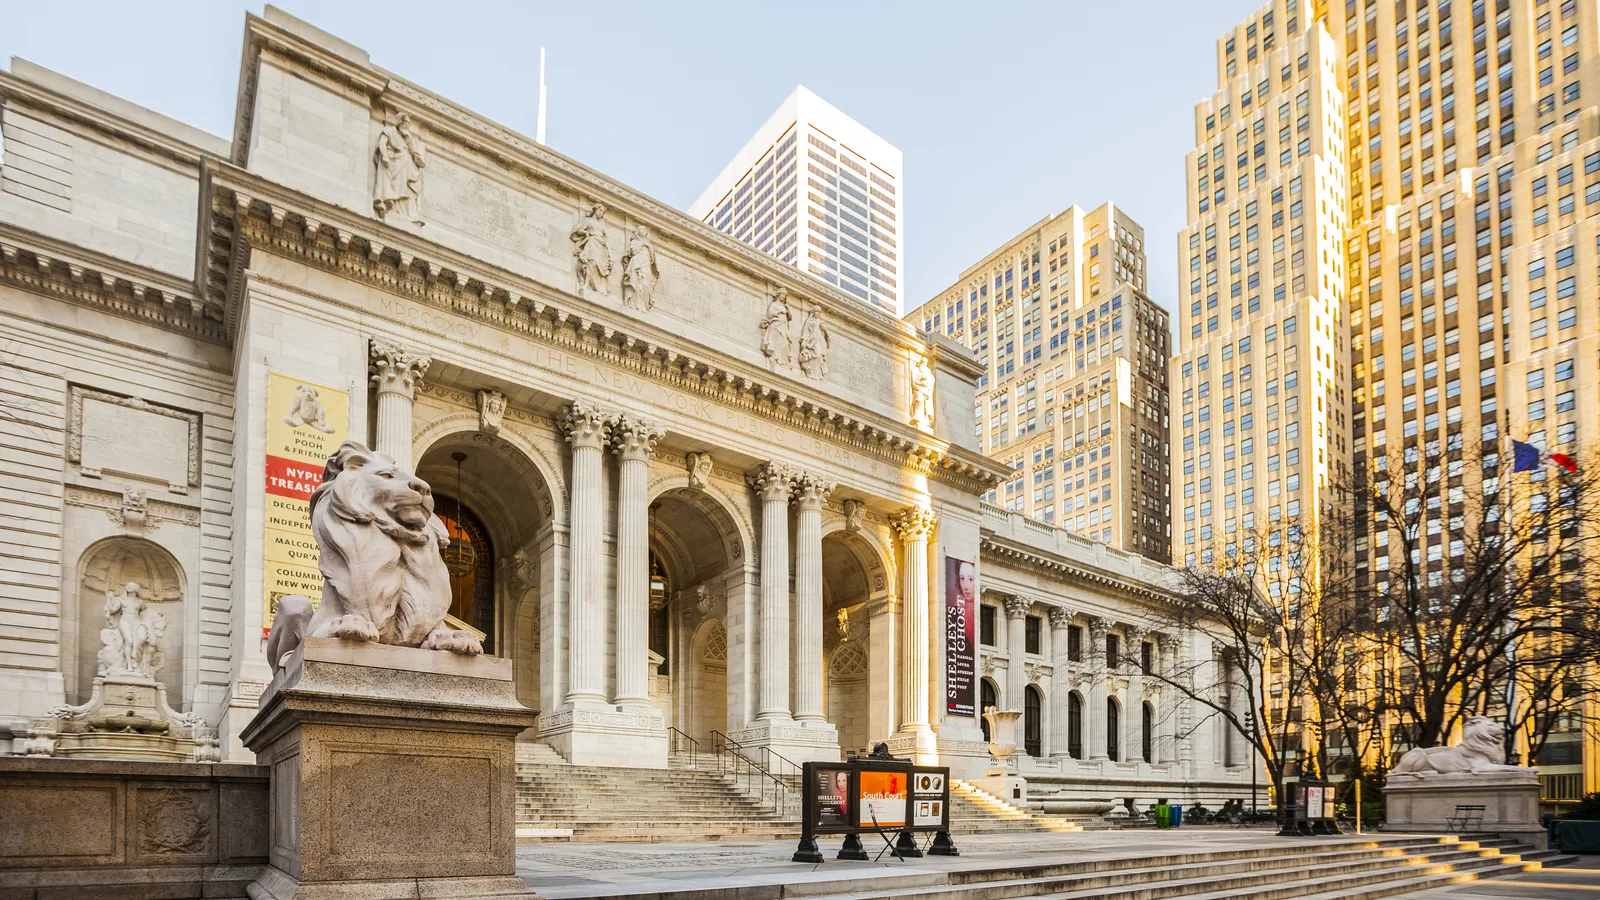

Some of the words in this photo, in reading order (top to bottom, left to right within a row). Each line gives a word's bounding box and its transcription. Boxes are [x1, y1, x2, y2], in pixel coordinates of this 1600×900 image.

[467, 177, 509, 203] ASTOR
[380, 297, 481, 339] MDCCCXCV
[529, 343, 578, 375] THE
[594, 364, 645, 394] NEW
[663, 388, 713, 420] YORK
[725, 410, 785, 443] PUBLIC
[800, 435, 860, 468] LIBRARY
[293, 430, 306, 438] THE
[307, 432, 325, 442] REAL
[295, 438, 323, 450] POOH
[284, 445, 290, 453] &
[292, 447, 328, 461] FRIEND
[286, 467, 323, 483] NYPL'
[273, 500, 310, 514] DECLAR
[269, 516, 312, 531] INDEPEN
[288, 550, 318, 561] QUR'A
[276, 568, 323, 582] COLUMBU
[276, 579, 299, 588] NEW
[301, 582, 323, 592] WOR
[956, 594, 966, 652] GHOST
[948, 606, 957, 699] SHELLEY'S
[863, 791, 884, 799] South
[884, 791, 903, 799] Court
